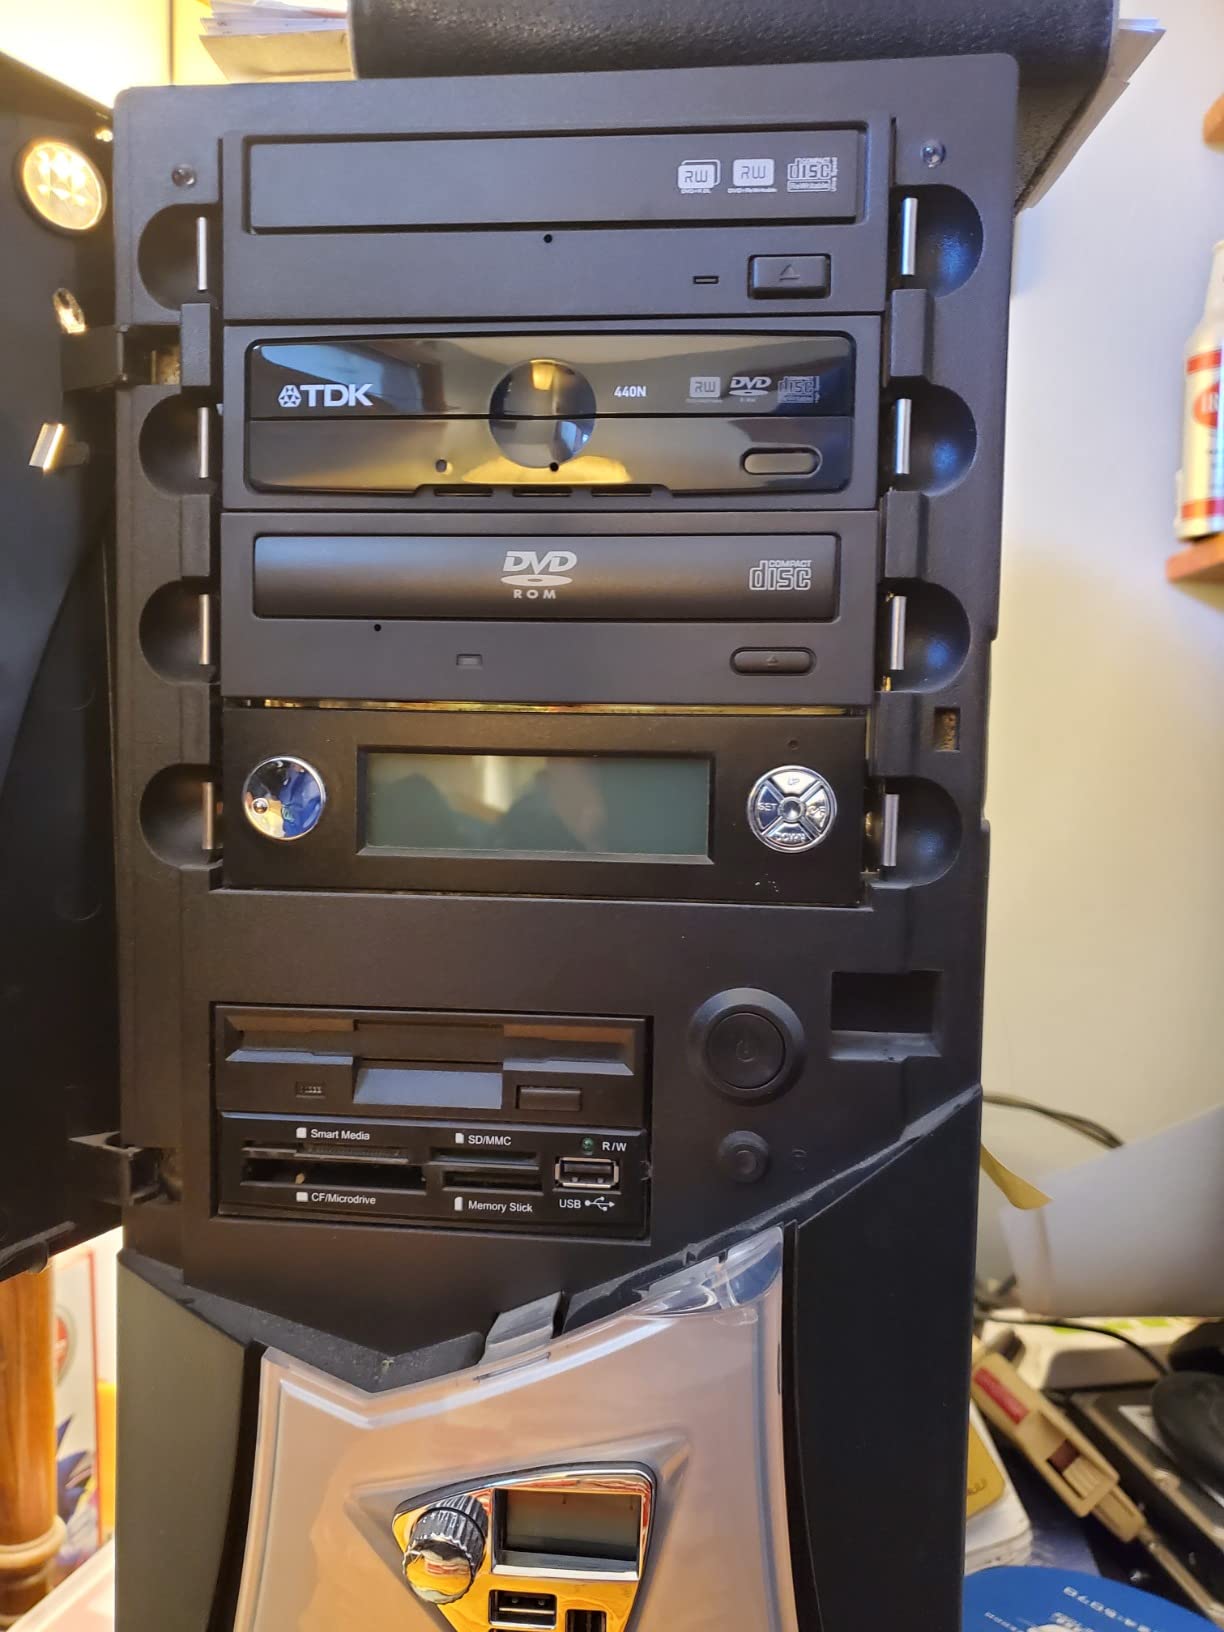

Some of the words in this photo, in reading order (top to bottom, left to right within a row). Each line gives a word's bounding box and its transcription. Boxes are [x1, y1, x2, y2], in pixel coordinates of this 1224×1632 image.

[684, 169, 709, 183] RW
[740, 165, 767, 180] RW
[694, 381, 716, 393] RW
[729, 376, 772, 390] DVD
[300, 383, 374, 407] TDK
[613, 385, 647, 398] 440N
[502, 550, 578, 575] DVD
[768, 560, 812, 568] COMPACT
[512, 589, 557, 600] ROM
[758, 802, 779, 812] SET
[310, 1128, 340, 1139] Smart
[341, 1130, 371, 1141] Media
[468, 1135, 512, 1146] SD/MMC
[311, 1193, 377, 1205] CF/Microdrive
[559, 1199, 582, 1209] USB
[468, 1200, 507, 1213] Memory
[509, 1202, 533, 1213] Stick
